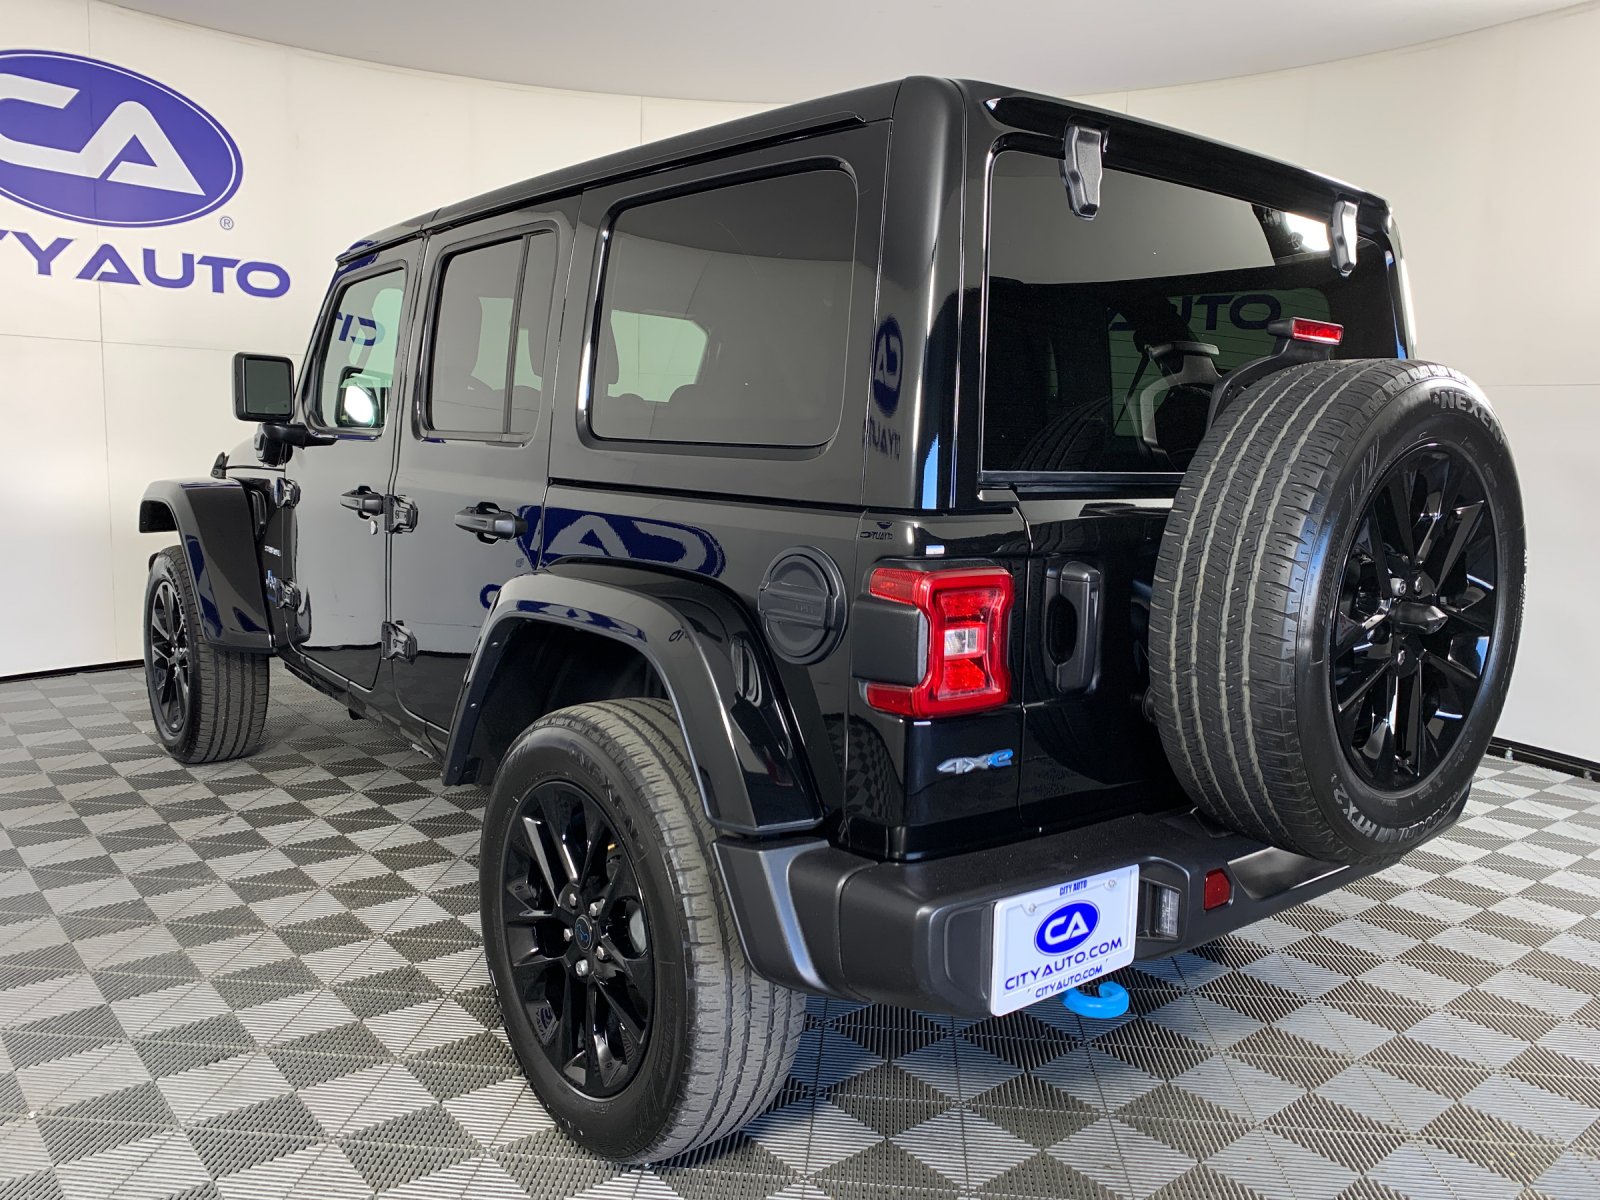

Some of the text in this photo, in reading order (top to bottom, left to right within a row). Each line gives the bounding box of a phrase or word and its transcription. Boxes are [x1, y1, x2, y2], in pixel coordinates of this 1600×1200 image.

[1059, 879, 1088, 897] CITY AUTO
[1044, 911, 1090, 946] CA
[1004, 936, 1123, 991] CITYAUTO.COM
[1035, 964, 1103, 999] CITYAUTO.COM
